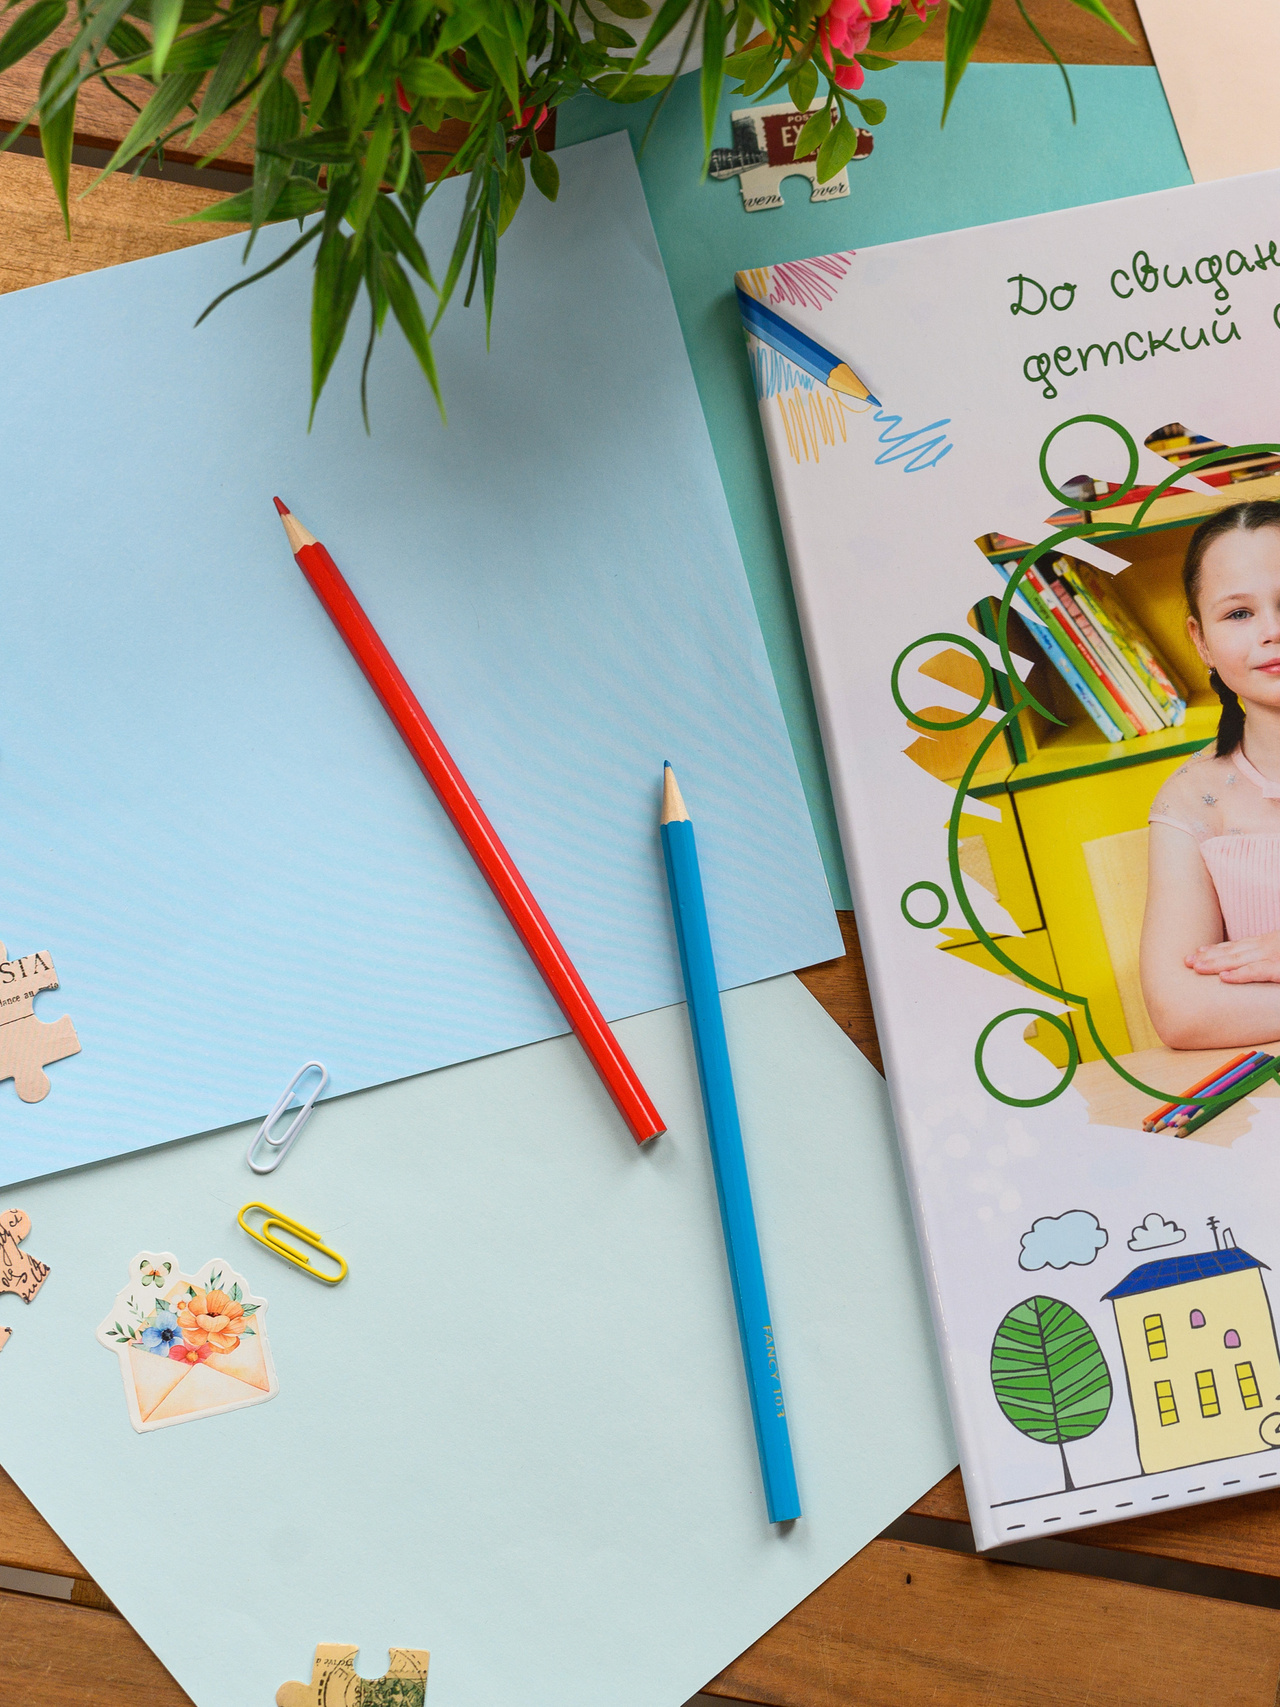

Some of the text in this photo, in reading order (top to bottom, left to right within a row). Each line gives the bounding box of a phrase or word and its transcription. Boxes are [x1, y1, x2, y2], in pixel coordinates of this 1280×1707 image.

[1007, 273, 1077, 316] До
[1023, 304, 1242, 400] детский
[762, 1325, 780, 1380] FANCY
